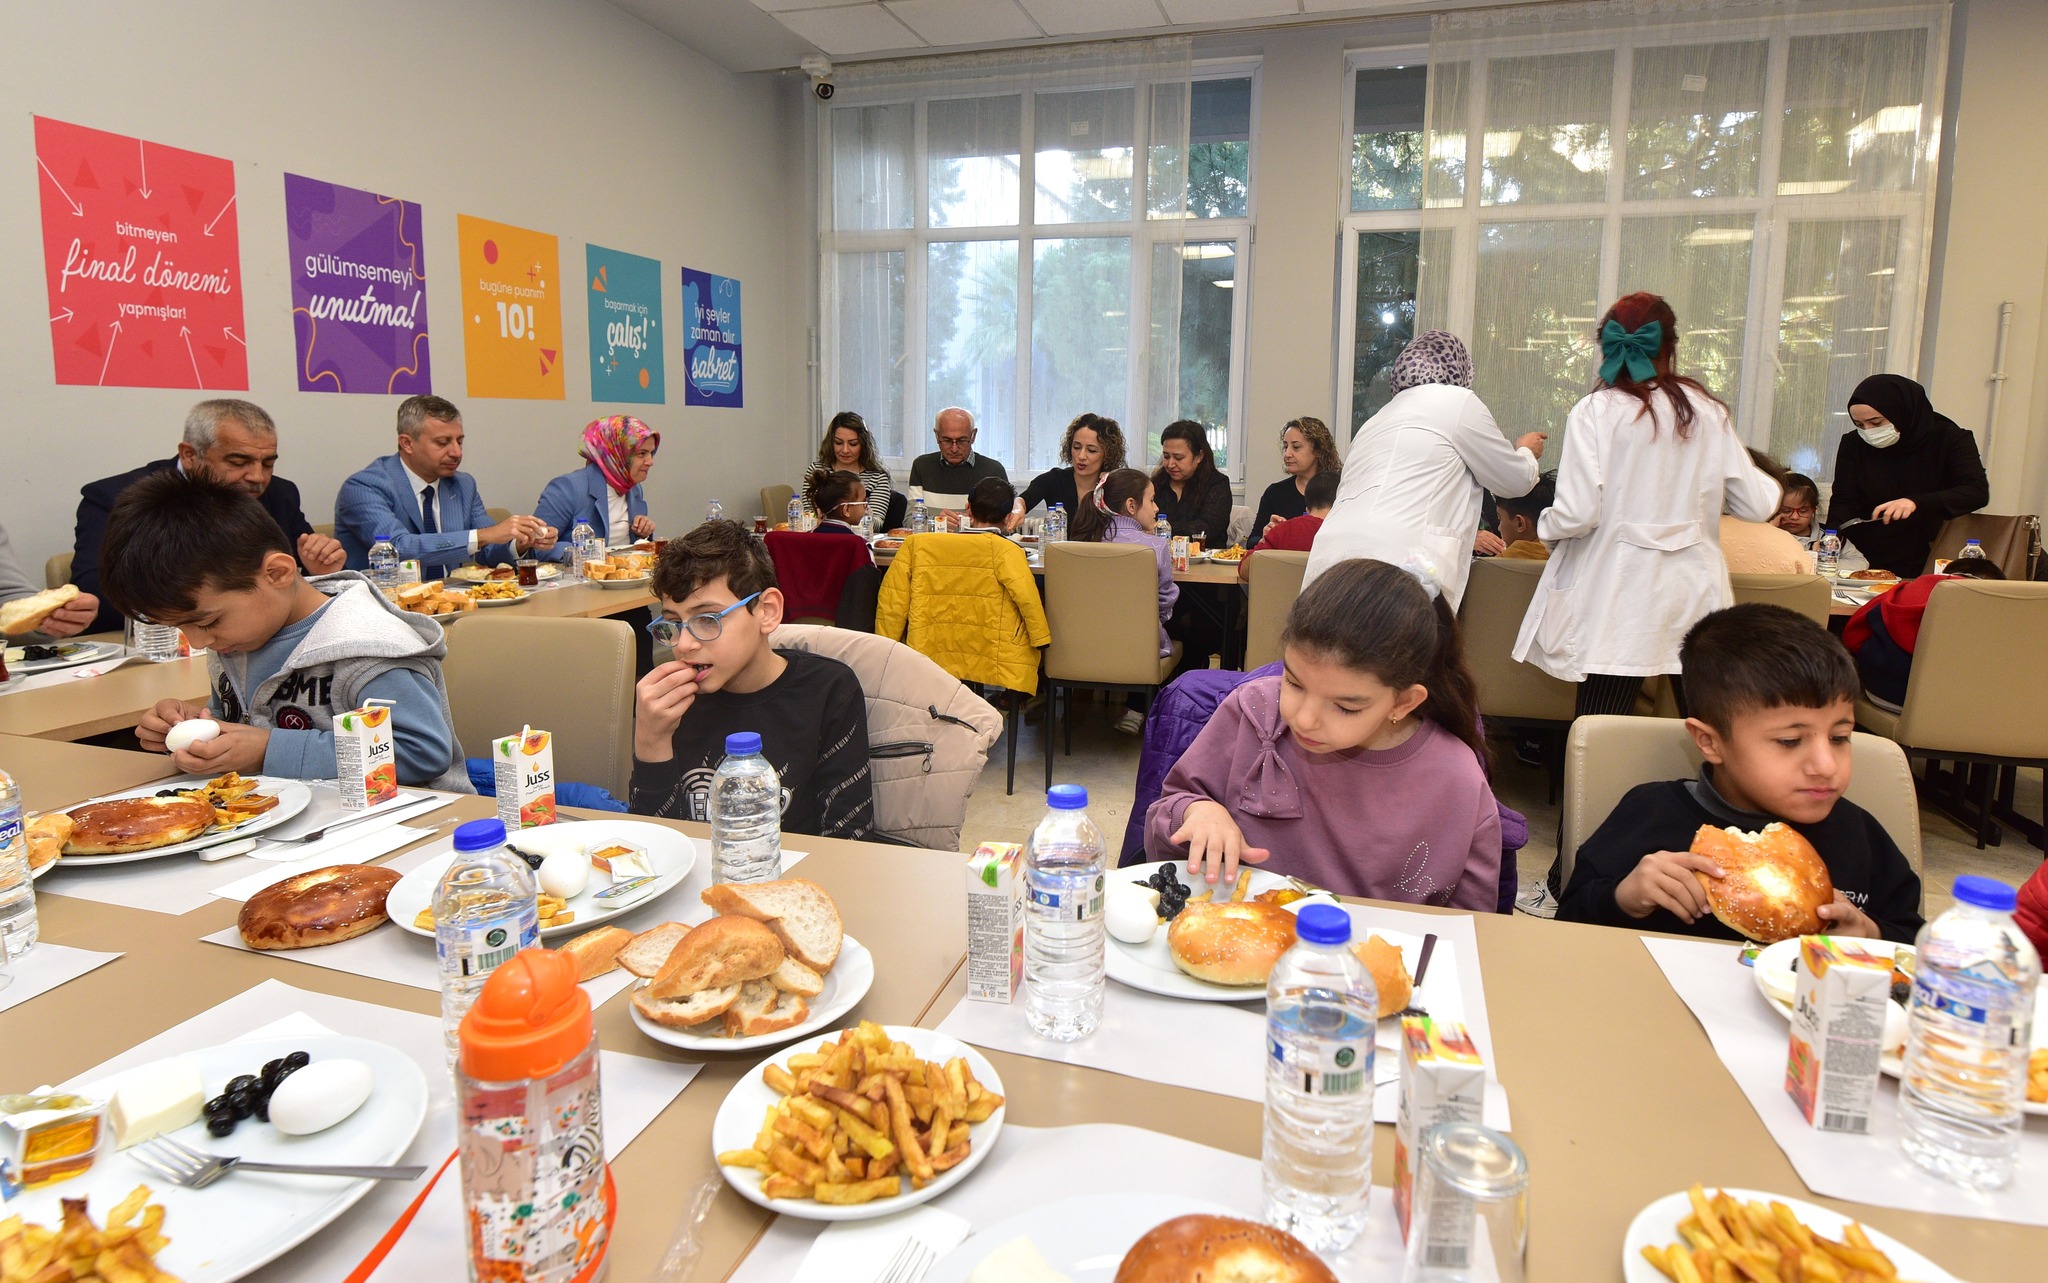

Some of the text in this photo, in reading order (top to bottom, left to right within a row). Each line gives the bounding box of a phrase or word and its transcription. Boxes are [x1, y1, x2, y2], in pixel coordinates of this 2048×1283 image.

[116, 221, 178, 244] bitmeyen
[60, 238, 231, 294] final dönemi
[305, 253, 413, 291] gülümsemeyi
[480, 279, 545, 299] bugüne puanım
[118, 303, 187, 322] yapmışlar!
[309, 284, 421, 330] unutma!
[604, 297, 648, 317] başarmak için
[694, 303, 731, 326] iyi şeyler
[496, 301, 535, 341] 10!
[607, 314, 648, 359] çalış!
[690, 326, 736, 344] zaman alır
[691, 345, 737, 381] sabret
[368, 742, 390, 758] Juss
[525, 770, 550, 788] Juss
